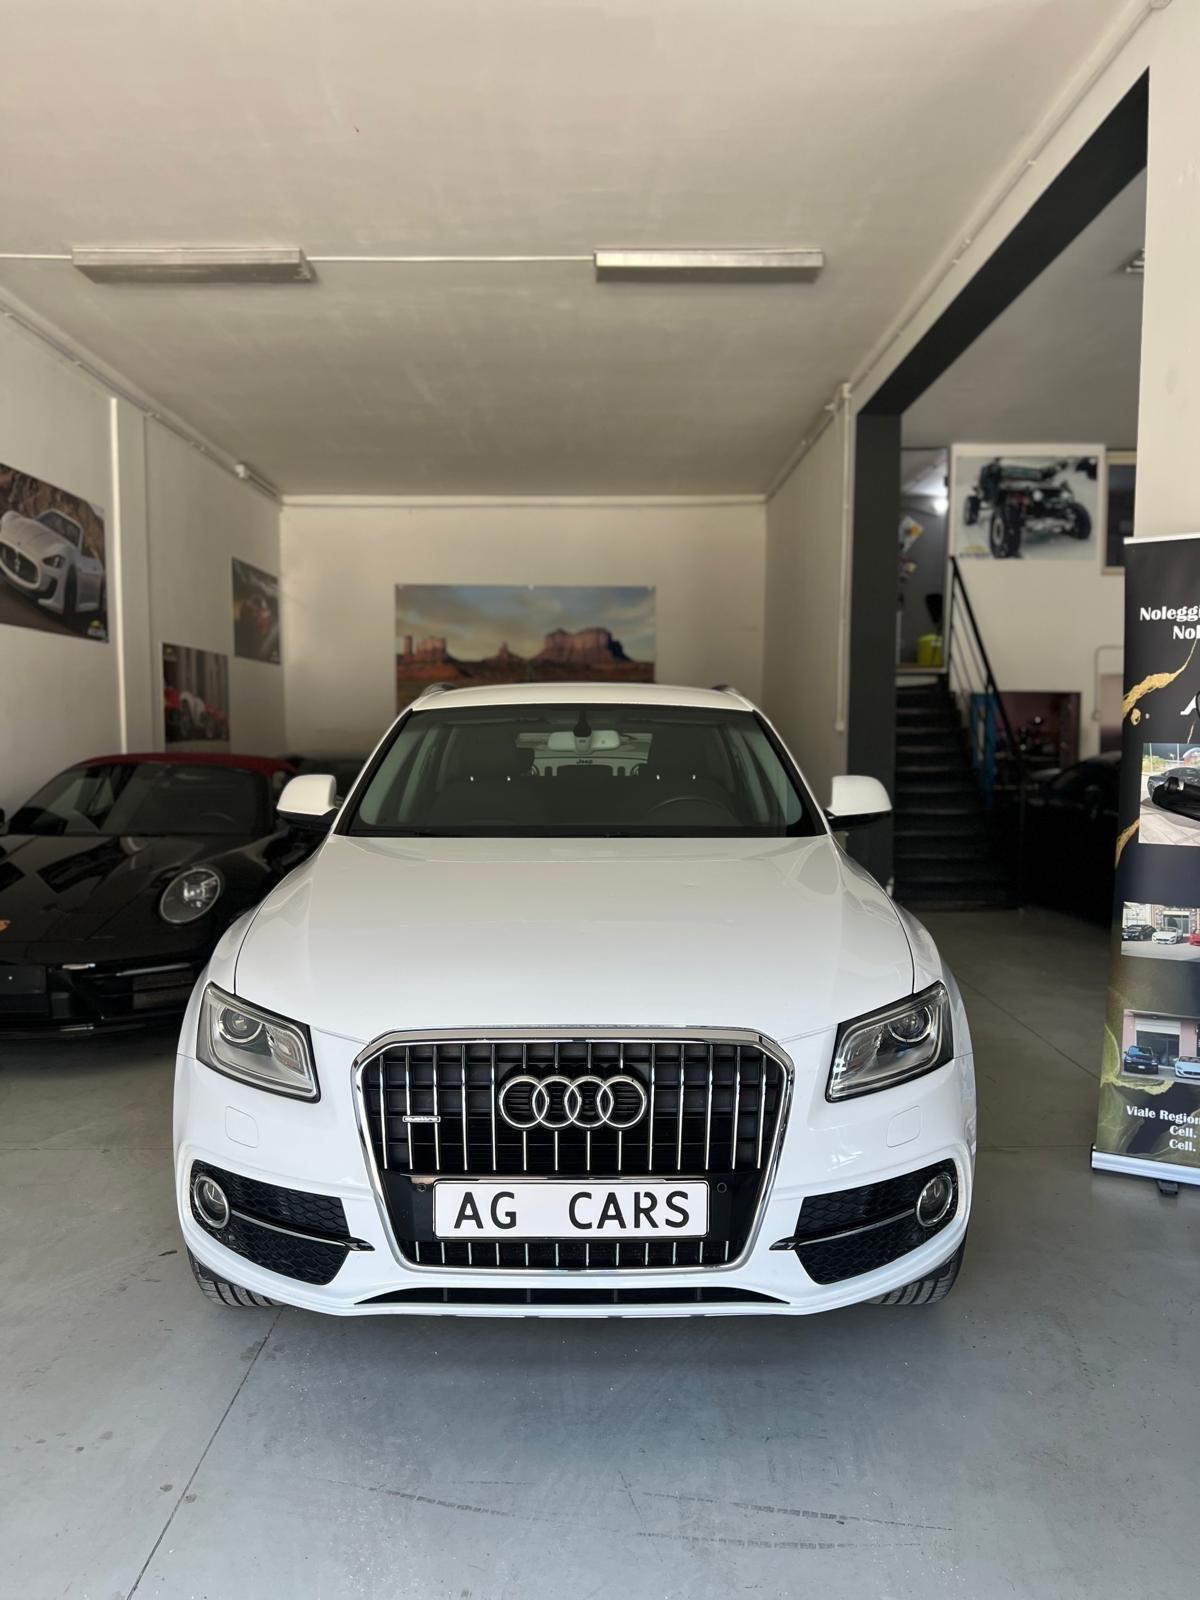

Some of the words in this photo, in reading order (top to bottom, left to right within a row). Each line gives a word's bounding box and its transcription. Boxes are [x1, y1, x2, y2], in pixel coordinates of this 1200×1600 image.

[1173, 624, 1200, 640] Nol
[1126, 1105, 1156, 1118] Viale
[1170, 1125, 1197, 1138] Cell.
[1169, 1138, 1196, 1152] Cell.
[454, 1191, 517, 1230] AG
[568, 1190, 690, 1230] CARS
